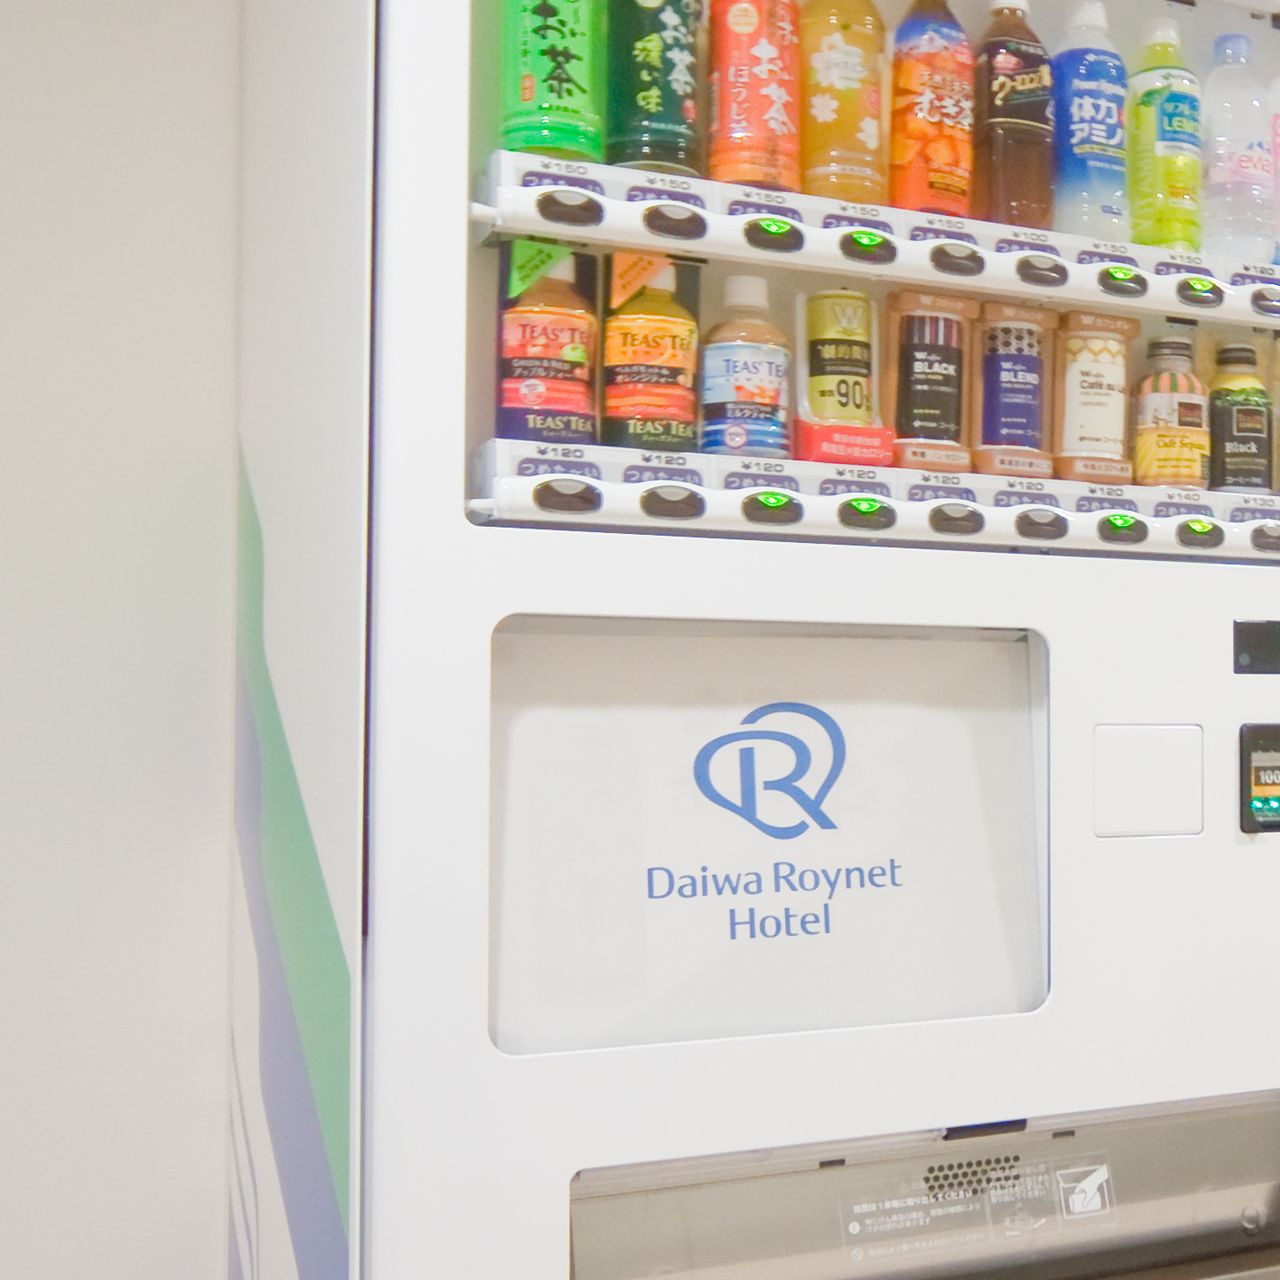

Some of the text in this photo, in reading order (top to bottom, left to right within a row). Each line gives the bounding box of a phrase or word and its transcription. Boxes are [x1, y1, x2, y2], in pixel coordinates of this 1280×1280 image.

[659, 4, 696, 96] お茶
[750, 38, 797, 136] お茶
[1069, 95, 1118, 125] 体力
[1069, 121, 1124, 146] アミノ
[541, 159, 588, 176] ¥150
[646, 174, 691, 191] ¥150
[743, 189, 786, 205] ¥150
[838, 203, 880, 218] ¥150
[926, 216, 965, 231] ¥150
[1012, 230, 1049, 243] ¥100
[1092, 241, 1128, 255] ¥150
[833, 304, 863, 330] W
[912, 361, 957, 376] BLACK
[1000, 370, 1040, 385] BLEND
[569, 416, 593, 432] TEA
[669, 421, 693, 437] TEA
[535, 445, 584, 459] ¥120
[1224, 442, 1259, 454] Black
[641, 453, 687, 467] ¥120
[741, 460, 784, 473] ¥120
[836, 468, 876, 480] ¥120
[921, 473, 961, 485] ¥120
[1007, 480, 1045, 492] ¥120
[1088, 486, 1124, 497] ¥120
[646, 858, 903, 901] Daiwa Roynet
[728, 902, 832, 941] Hotel
